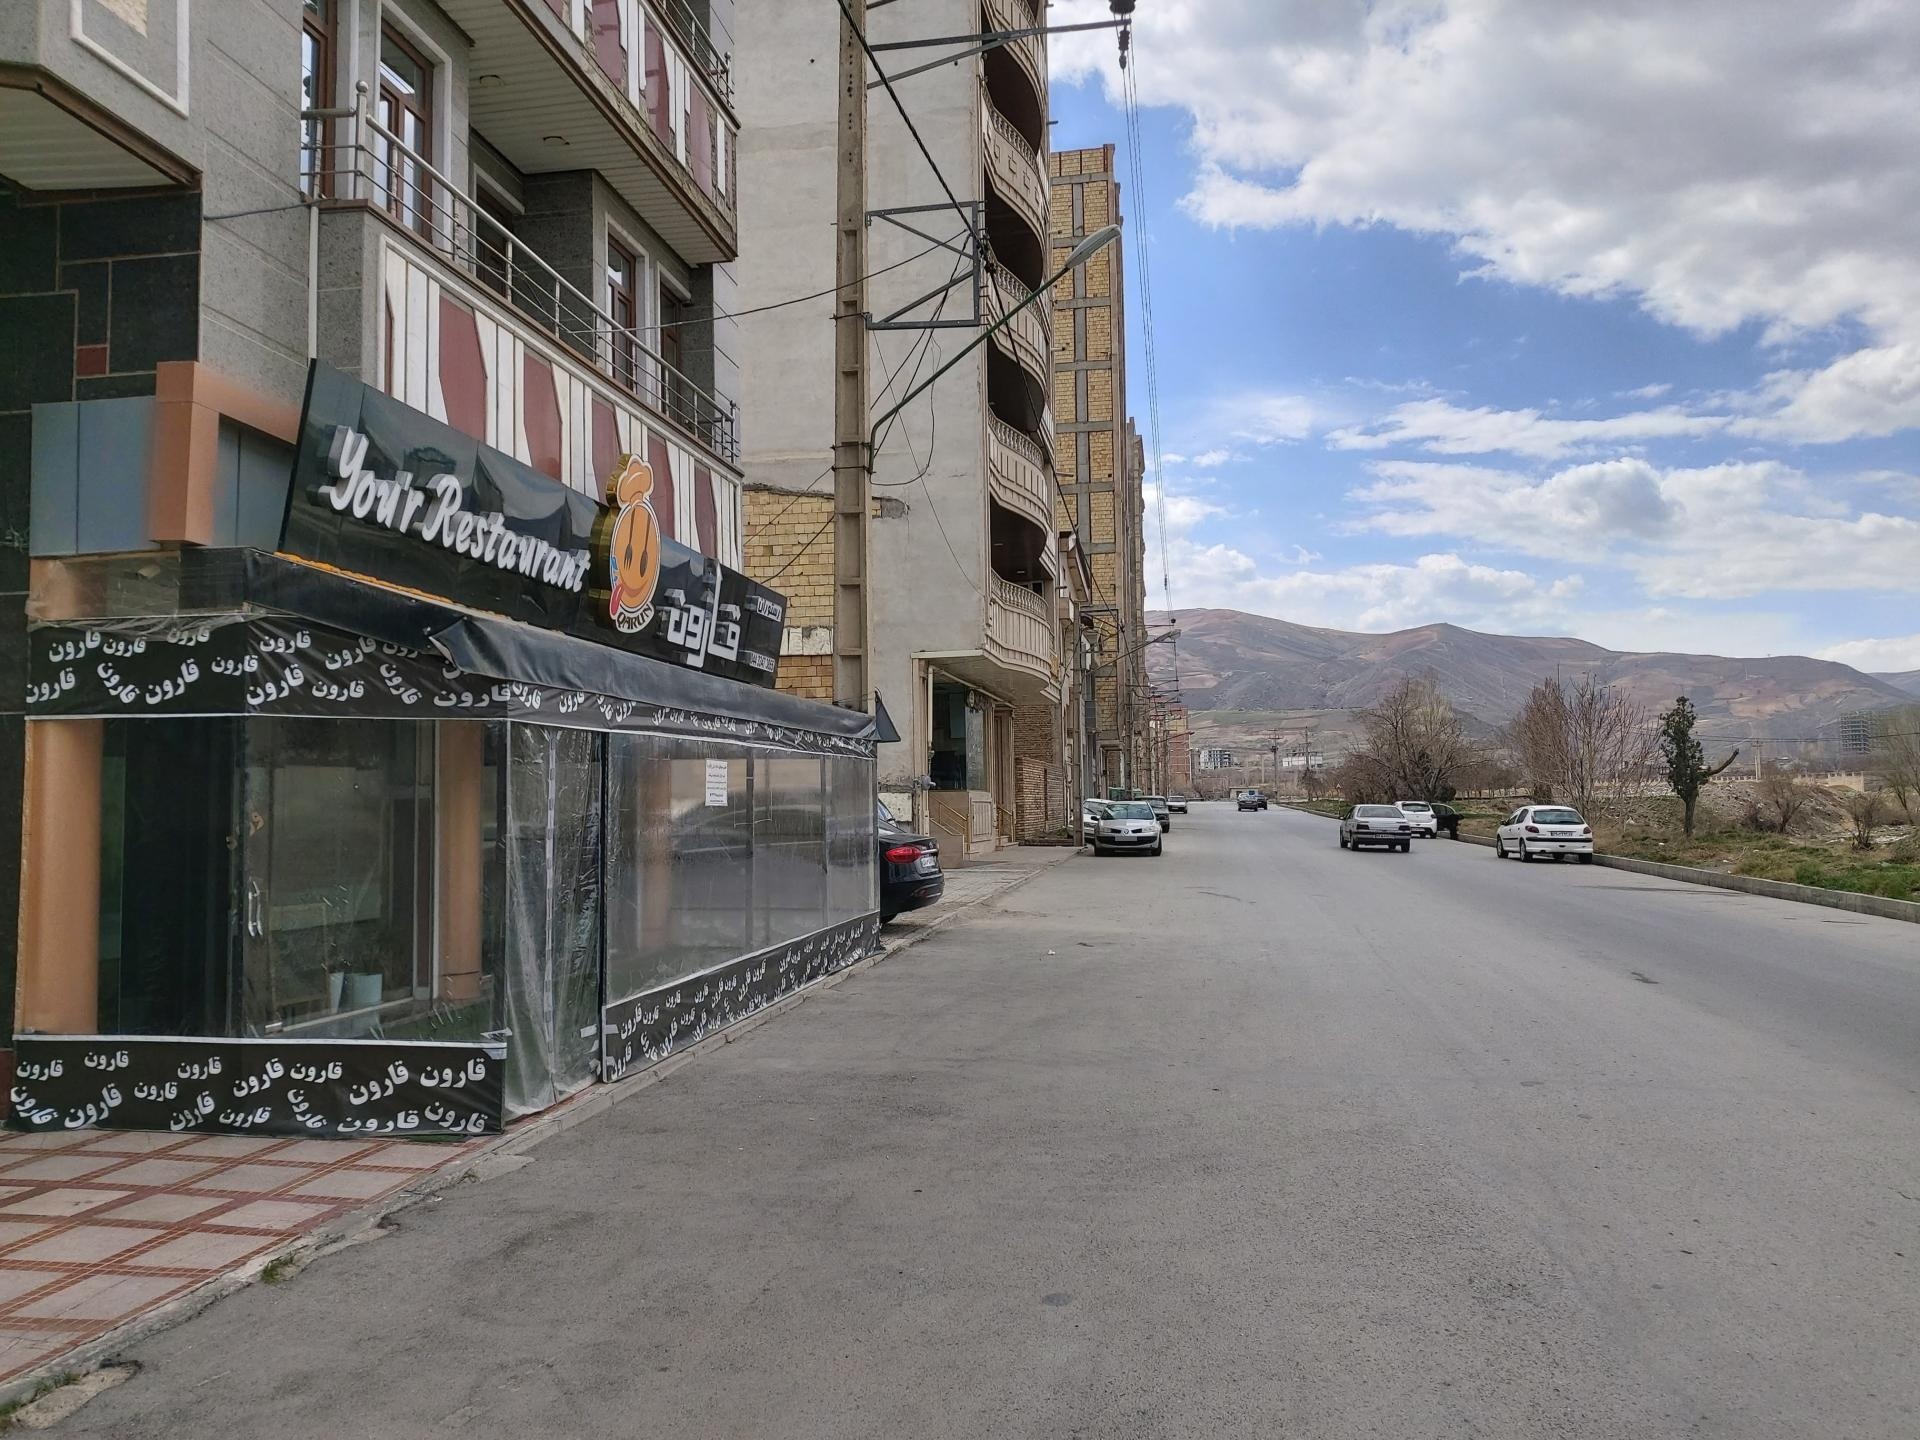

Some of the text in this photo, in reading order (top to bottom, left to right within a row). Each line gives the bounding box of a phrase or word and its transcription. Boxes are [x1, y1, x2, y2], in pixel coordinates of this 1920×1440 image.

[421, 473, 591, 593] Restaurant
[616, 603, 653, 630] QARUN
[667, 562, 741, 668] قارون
[49, 629, 101, 662] قارون
[102, 635, 147, 657] قارون
[259, 630, 312, 653] قارون
[145, 658, 200, 705] قارون
[211, 655, 259, 676] قارون
[25, 667, 76, 704] قارون
[97, 662, 140, 704] قارون
[246, 663, 305, 705] قارون
[311, 680, 366, 701] قارون
[379, 662, 423, 704] قارون
[433, 682, 511, 708] قارون
[620, 1003, 642, 1039] قارون
[16, 1060, 64, 1081] قارون
[84, 1051, 130, 1071] قارون
[177, 1057, 222, 1080] قارون
[289, 1061, 343, 1084] قارون
[420, 1057, 486, 1089] قارون
[133, 1082, 178, 1101] قارون
[233, 1058, 285, 1098] قارون
[350, 1060, 409, 1105] قارون
[10, 1086, 59, 1125] قارون
[64, 1083, 123, 1129] قارون
[170, 1090, 215, 1131] قارون
[219, 1107, 273, 1128] قارون
[287, 1089, 328, 1129] قارون
[337, 1110, 420, 1133] قارون
[424, 1101, 489, 1133] قارون
